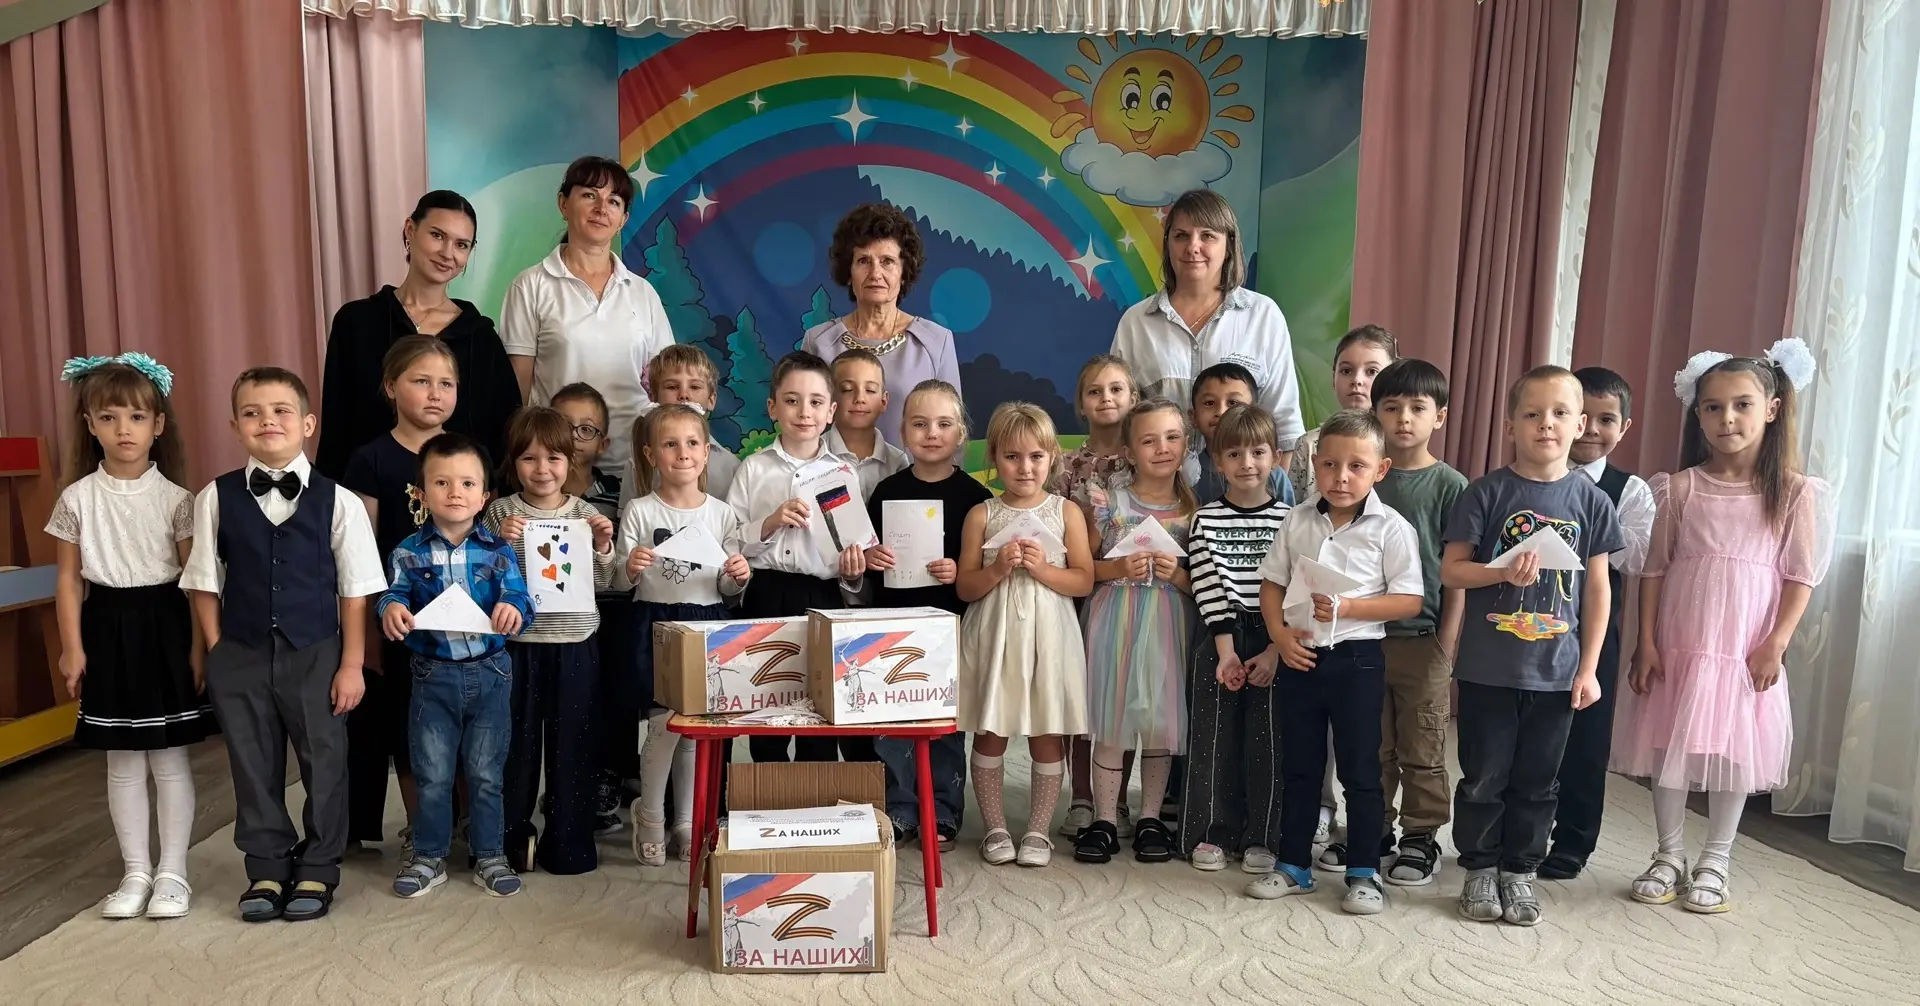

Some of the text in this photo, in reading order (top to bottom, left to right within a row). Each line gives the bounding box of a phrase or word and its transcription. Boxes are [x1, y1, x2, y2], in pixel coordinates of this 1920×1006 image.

[1215, 528, 1277, 539] EVERY DAY
[1215, 541, 1272, 552] IS A FRES
[1227, 555, 1265, 565] START
[857, 686, 955, 706] ЗА НАШИХ!
[718, 694, 743, 711] ЗА
[790, 828, 841, 837] НАШИХ
[735, 947, 870, 967] ЗА НАШИХ!
